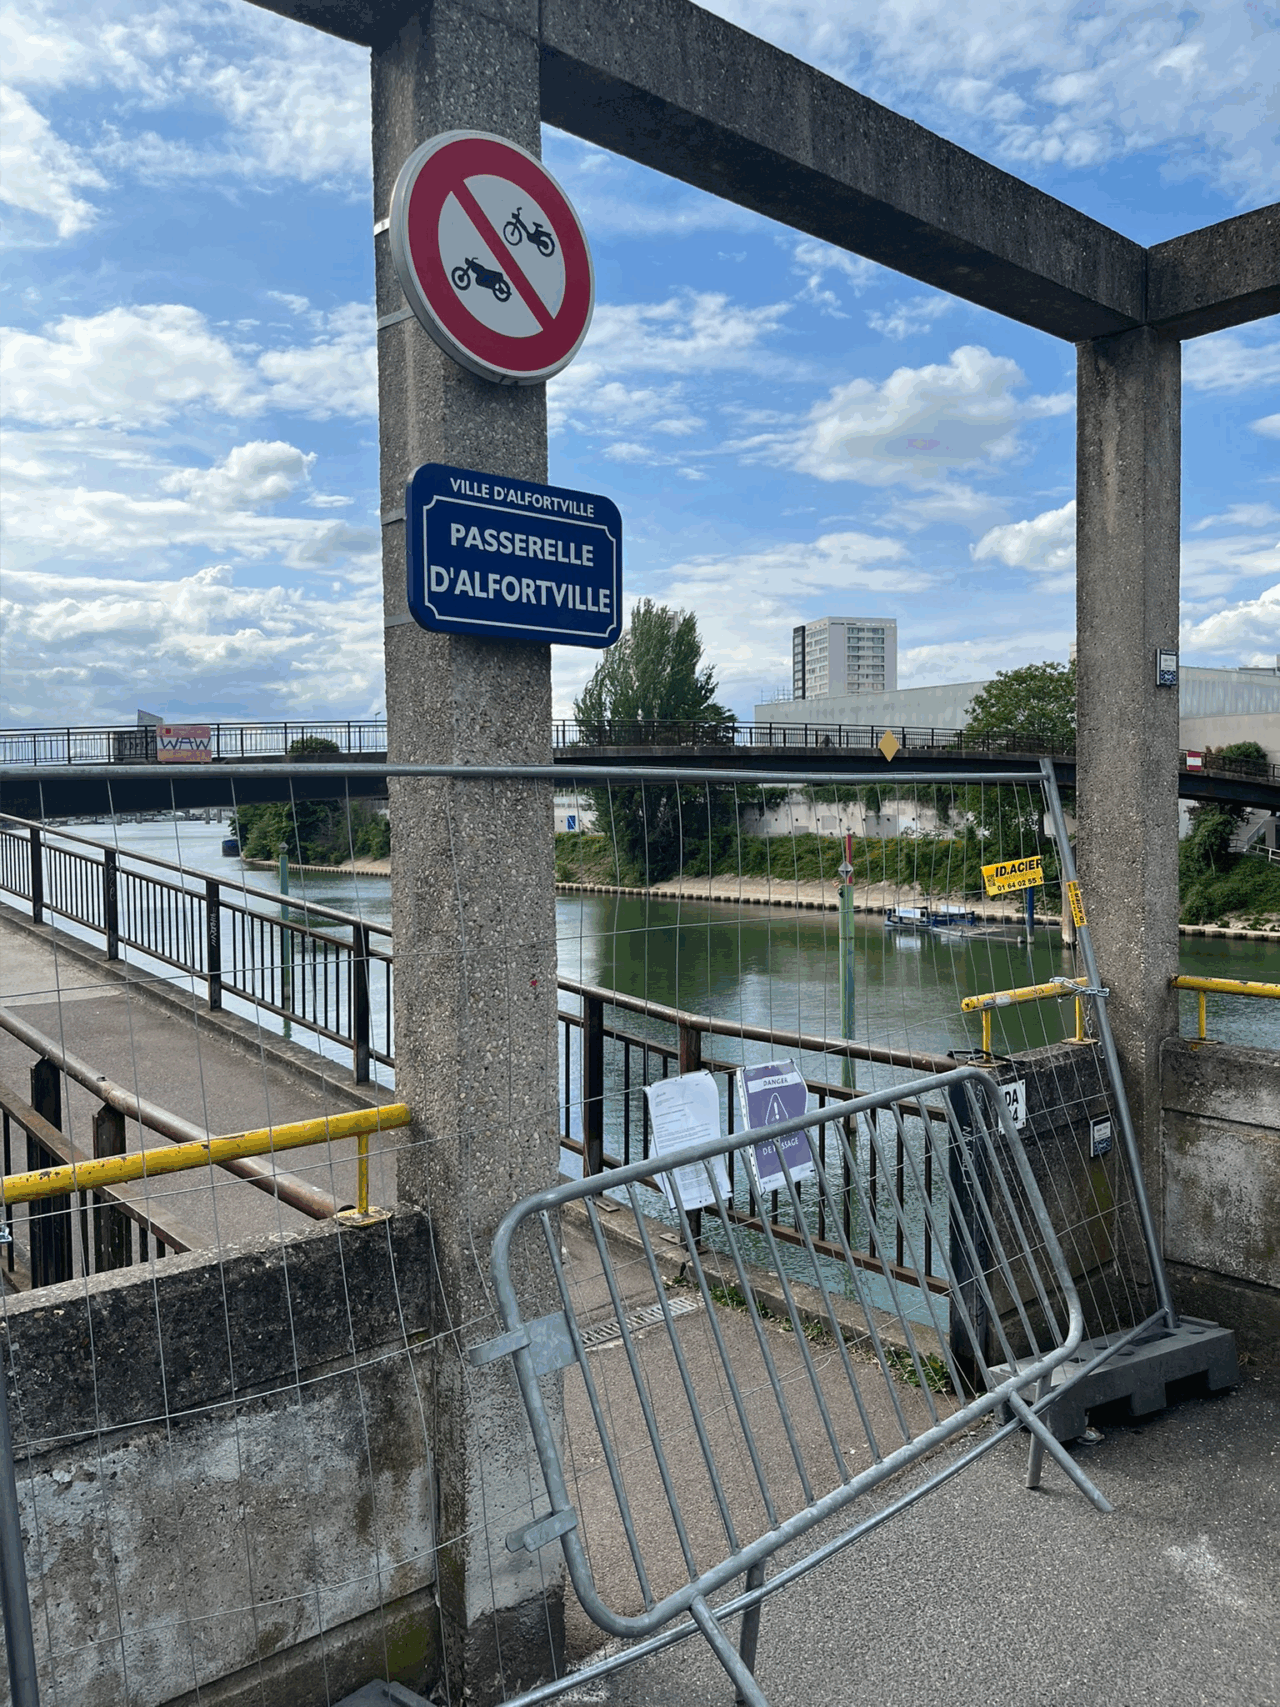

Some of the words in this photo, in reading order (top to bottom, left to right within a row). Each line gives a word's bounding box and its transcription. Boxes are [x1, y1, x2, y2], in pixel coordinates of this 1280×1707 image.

[450, 477, 490, 499] VILLE
[493, 486, 594, 518] D'ALFORTVILLE
[450, 522, 594, 567] PASSERELLE
[430, 564, 611, 614] D'ALFORTVILLE
[1017, 879, 1026, 887] 02
[1028, 877, 1037, 885] 55
[763, 1077, 788, 1087] DANGER
[762, 1145, 772, 1156] DE
[773, 1137, 799, 1152] SSAGE
